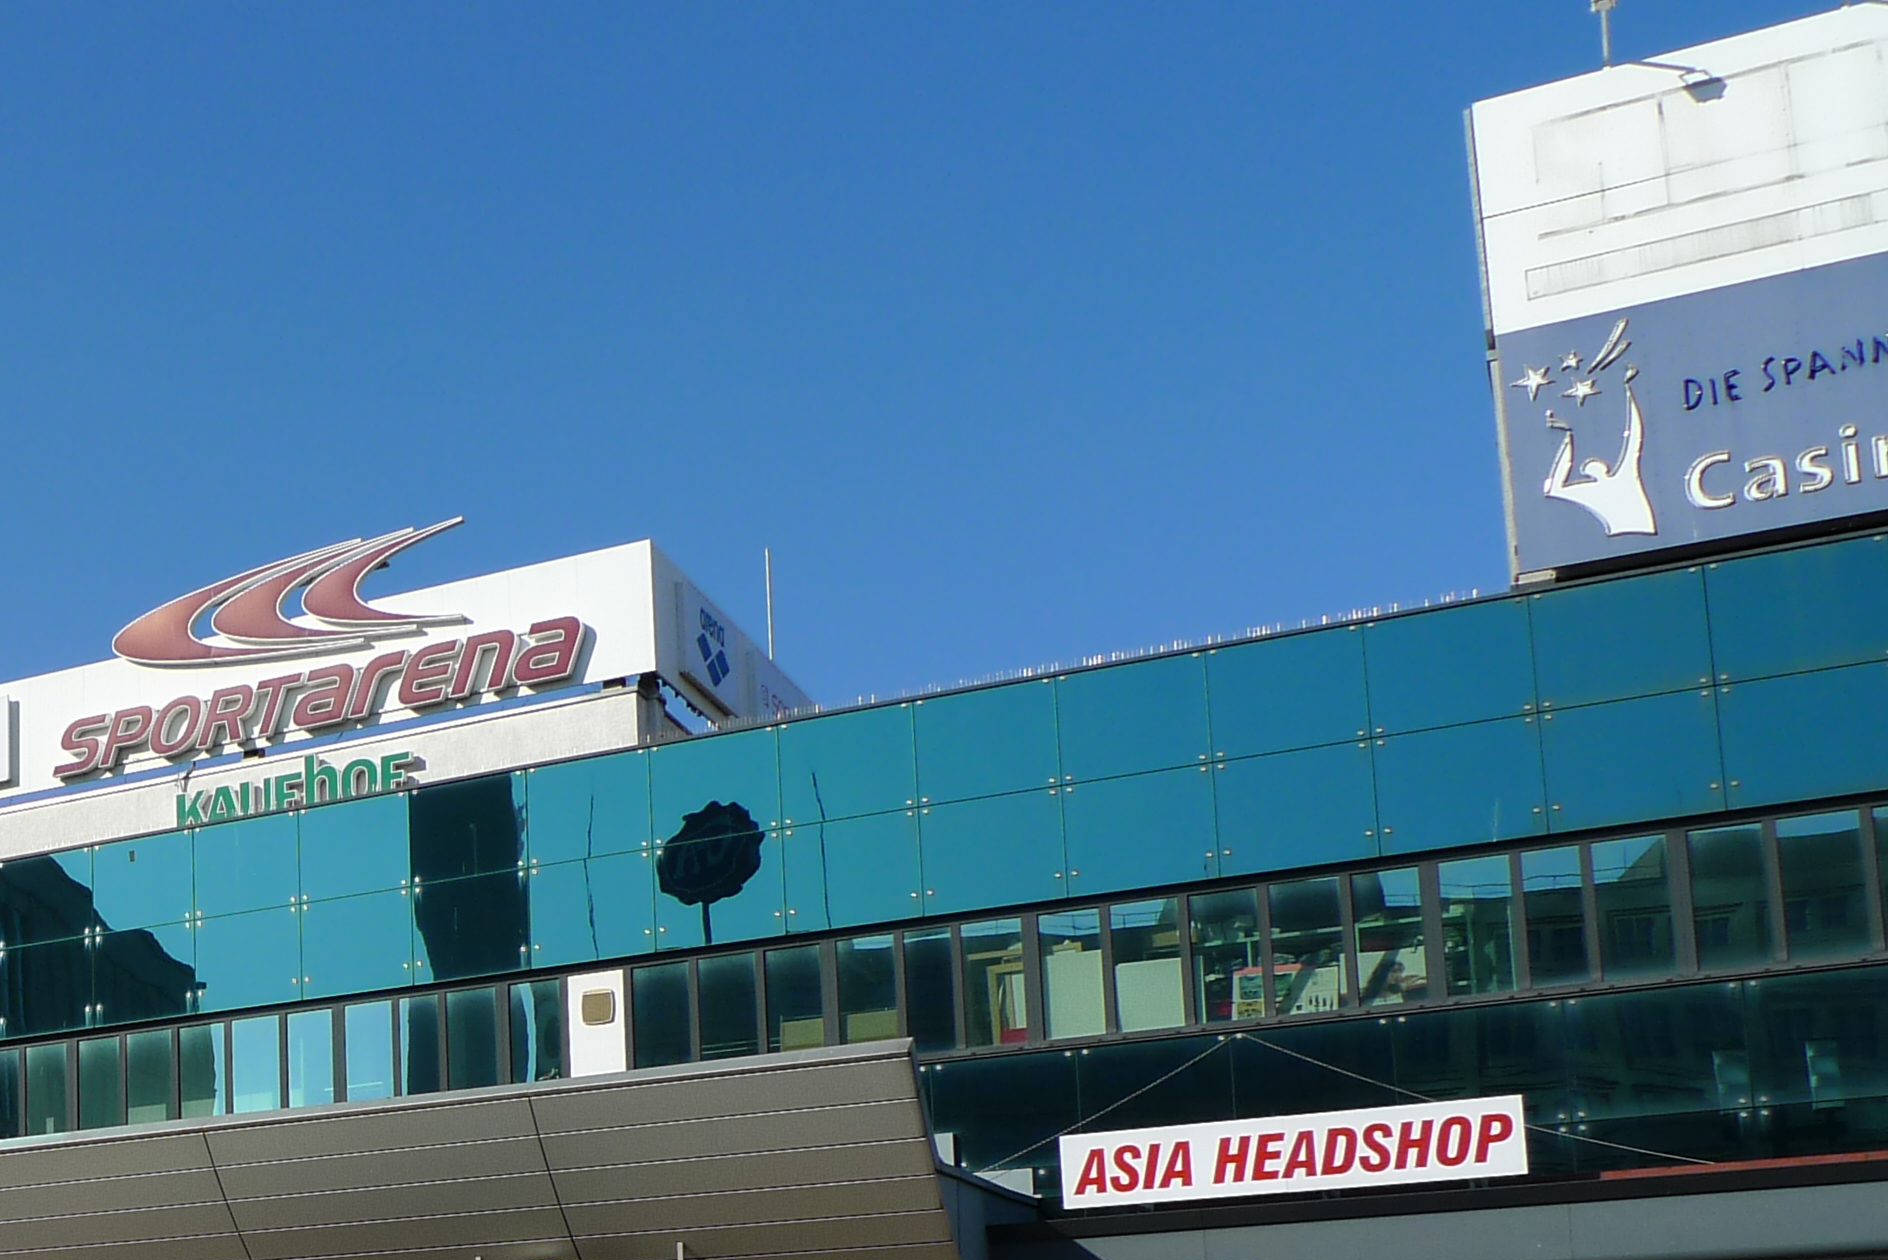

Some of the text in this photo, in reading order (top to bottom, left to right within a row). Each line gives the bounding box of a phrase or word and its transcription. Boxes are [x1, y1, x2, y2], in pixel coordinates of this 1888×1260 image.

[1682, 367, 1742, 411] DIE
[1074, 1113, 1514, 1196] ASIA HEADSHOP
